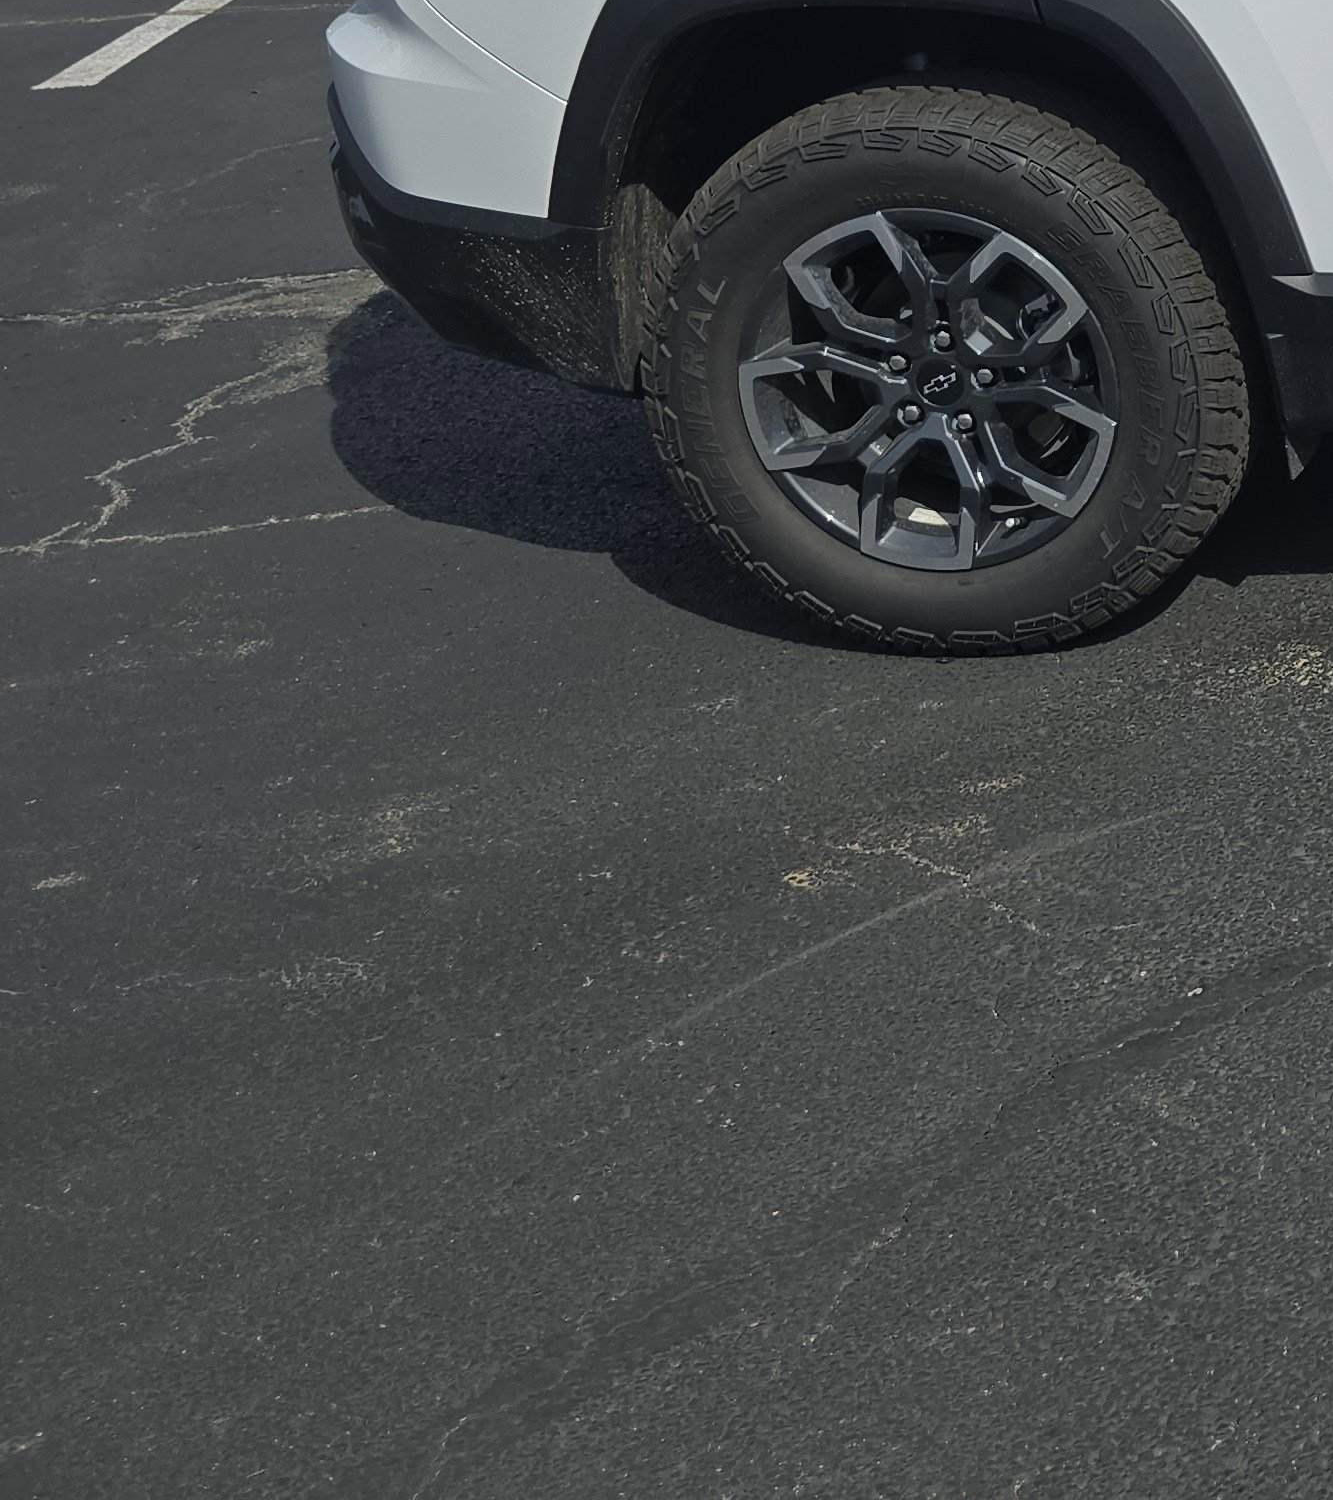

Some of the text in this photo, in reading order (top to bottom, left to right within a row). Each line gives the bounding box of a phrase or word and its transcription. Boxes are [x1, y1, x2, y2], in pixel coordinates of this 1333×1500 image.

[680, 275, 762, 523] GENERAL
[1046, 220, 1165, 559] GRABBER A/T
